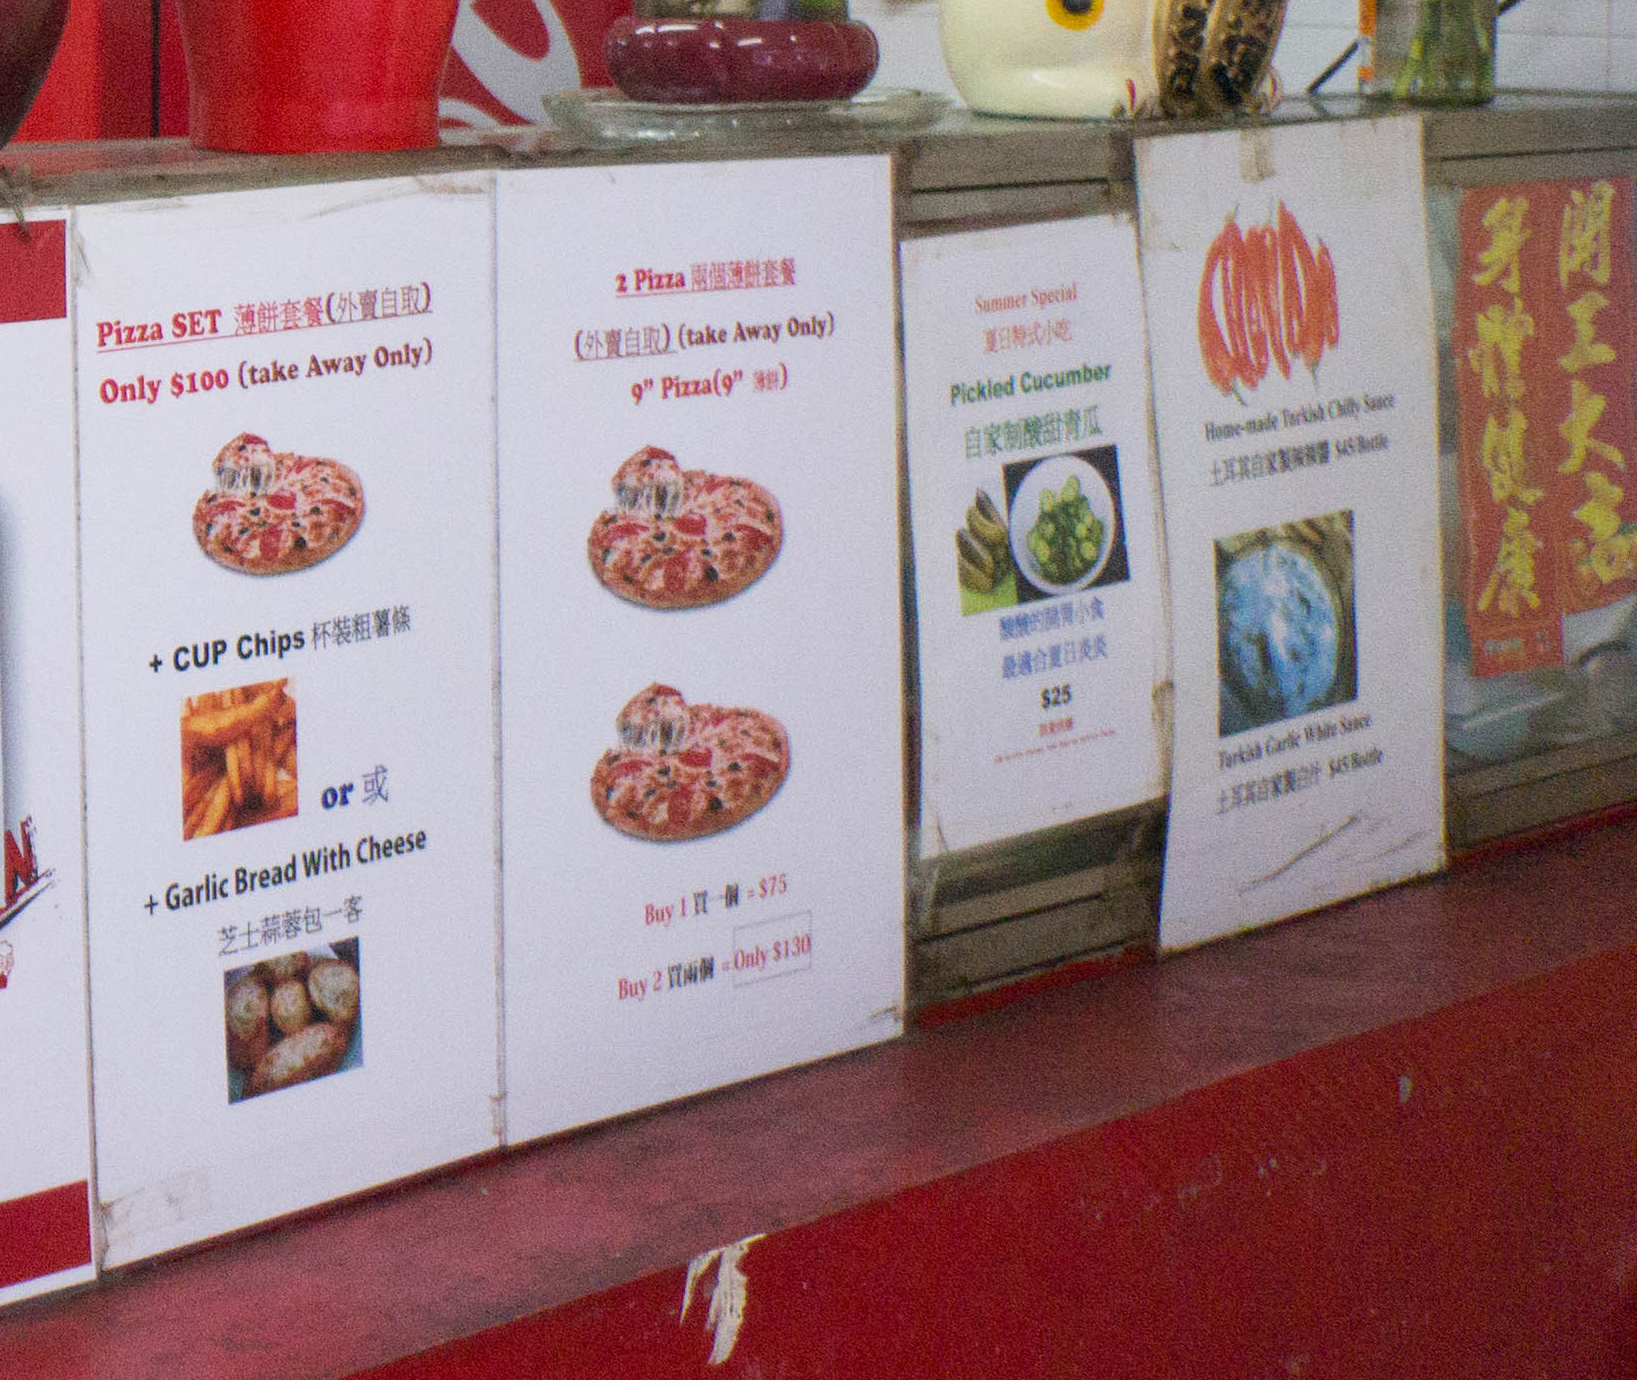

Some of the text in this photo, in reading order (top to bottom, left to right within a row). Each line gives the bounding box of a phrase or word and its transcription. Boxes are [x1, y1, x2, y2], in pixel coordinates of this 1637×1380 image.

[614, 272, 628, 294] 2
[633, 267, 686, 292] Pizza
[974, 282, 1078, 315] Summer Special
[96, 318, 163, 348] Pizza
[170, 308, 223, 338] SET
[677, 322, 728, 349] (take
[732, 319, 783, 344] Away
[786, 310, 835, 340] Only)
[98, 336, 433, 404] Only $100 (take Away Only)
[948, 362, 1113, 407] Pickled Cucumber
[1203, 410, 1278, 443] Home-made
[1280, 403, 1326, 430] Turkish
[1361, 391, 1396, 413] Sauce
[148, 653, 163, 673] +
[172, 638, 228, 672] CUP
[236, 629, 306, 661] Chips
[1039, 683, 1073, 710] $25
[1217, 712, 1373, 772] Turkish Garlic White Sauce
[321, 763, 390, 811] or 或
[143, 828, 428, 916] + Garlic Bread With Cheese
[644, 902, 675, 930] Buy
[757, 872, 788, 900] $75
[217, 893, 364, 958] 芝士蒜蓉包一客
[617, 975, 648, 1003] Buy
[652, 969, 663, 992] 2
[733, 944, 768, 972] Only
[772, 932, 812, 963] $130
